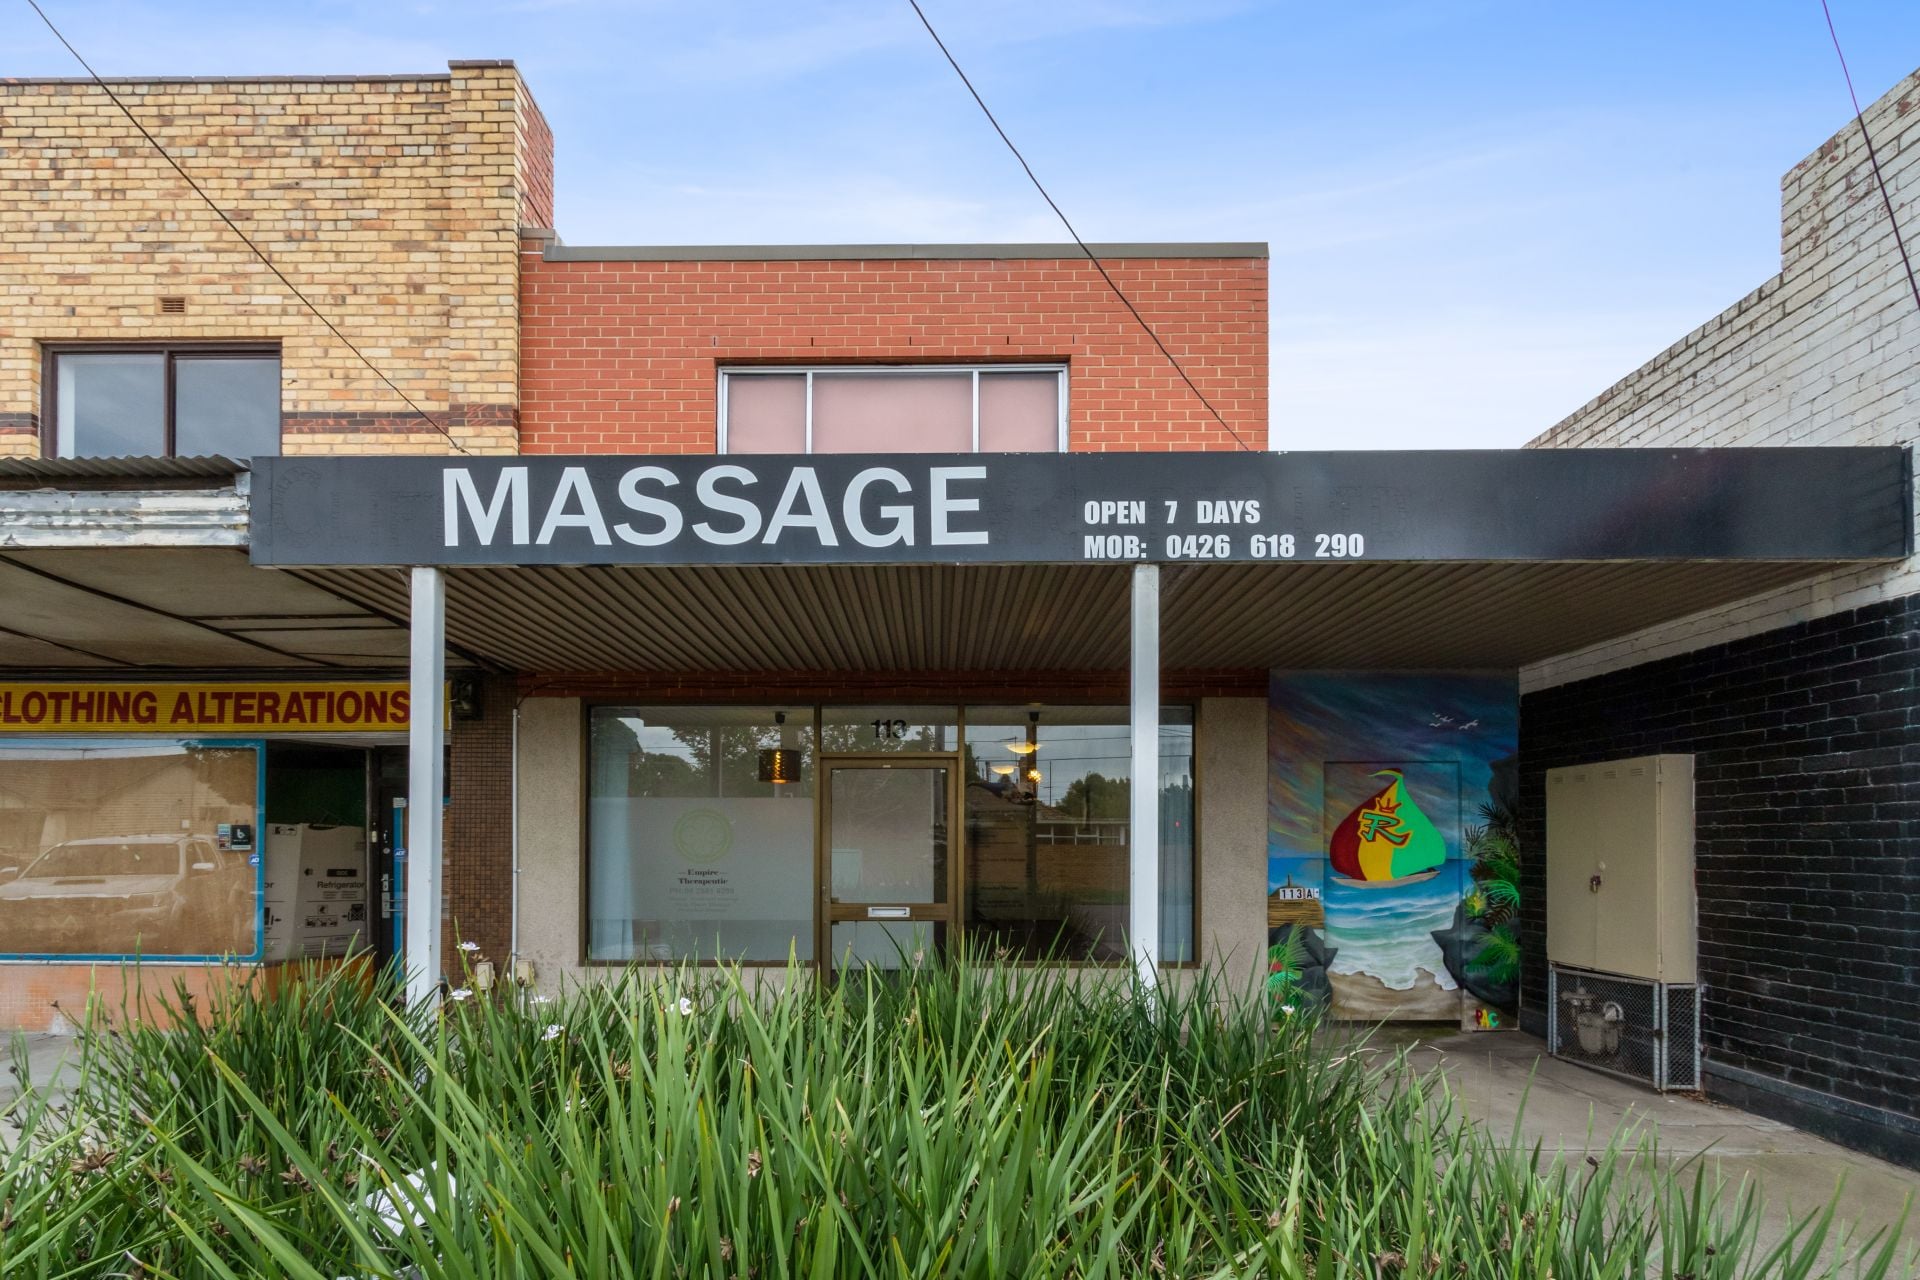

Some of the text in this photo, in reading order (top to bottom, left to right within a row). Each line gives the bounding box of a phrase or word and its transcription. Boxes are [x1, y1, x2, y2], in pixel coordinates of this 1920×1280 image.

[443, 465, 989, 548] MASSAGE
[1084, 499, 1260, 524] OPEN 7 DAYS
[1084, 533, 1364, 559] MOB: 0426 618 290
[0, 690, 410, 725] LOTHING ALTERATIONS
[870, 719, 907, 739] 113
[677, 877, 729, 886] Therapeutic
[687, 868, 720, 877] Empire
[316, 880, 366, 890] Refrigerator
[1475, 1008, 1500, 1029] PAC
